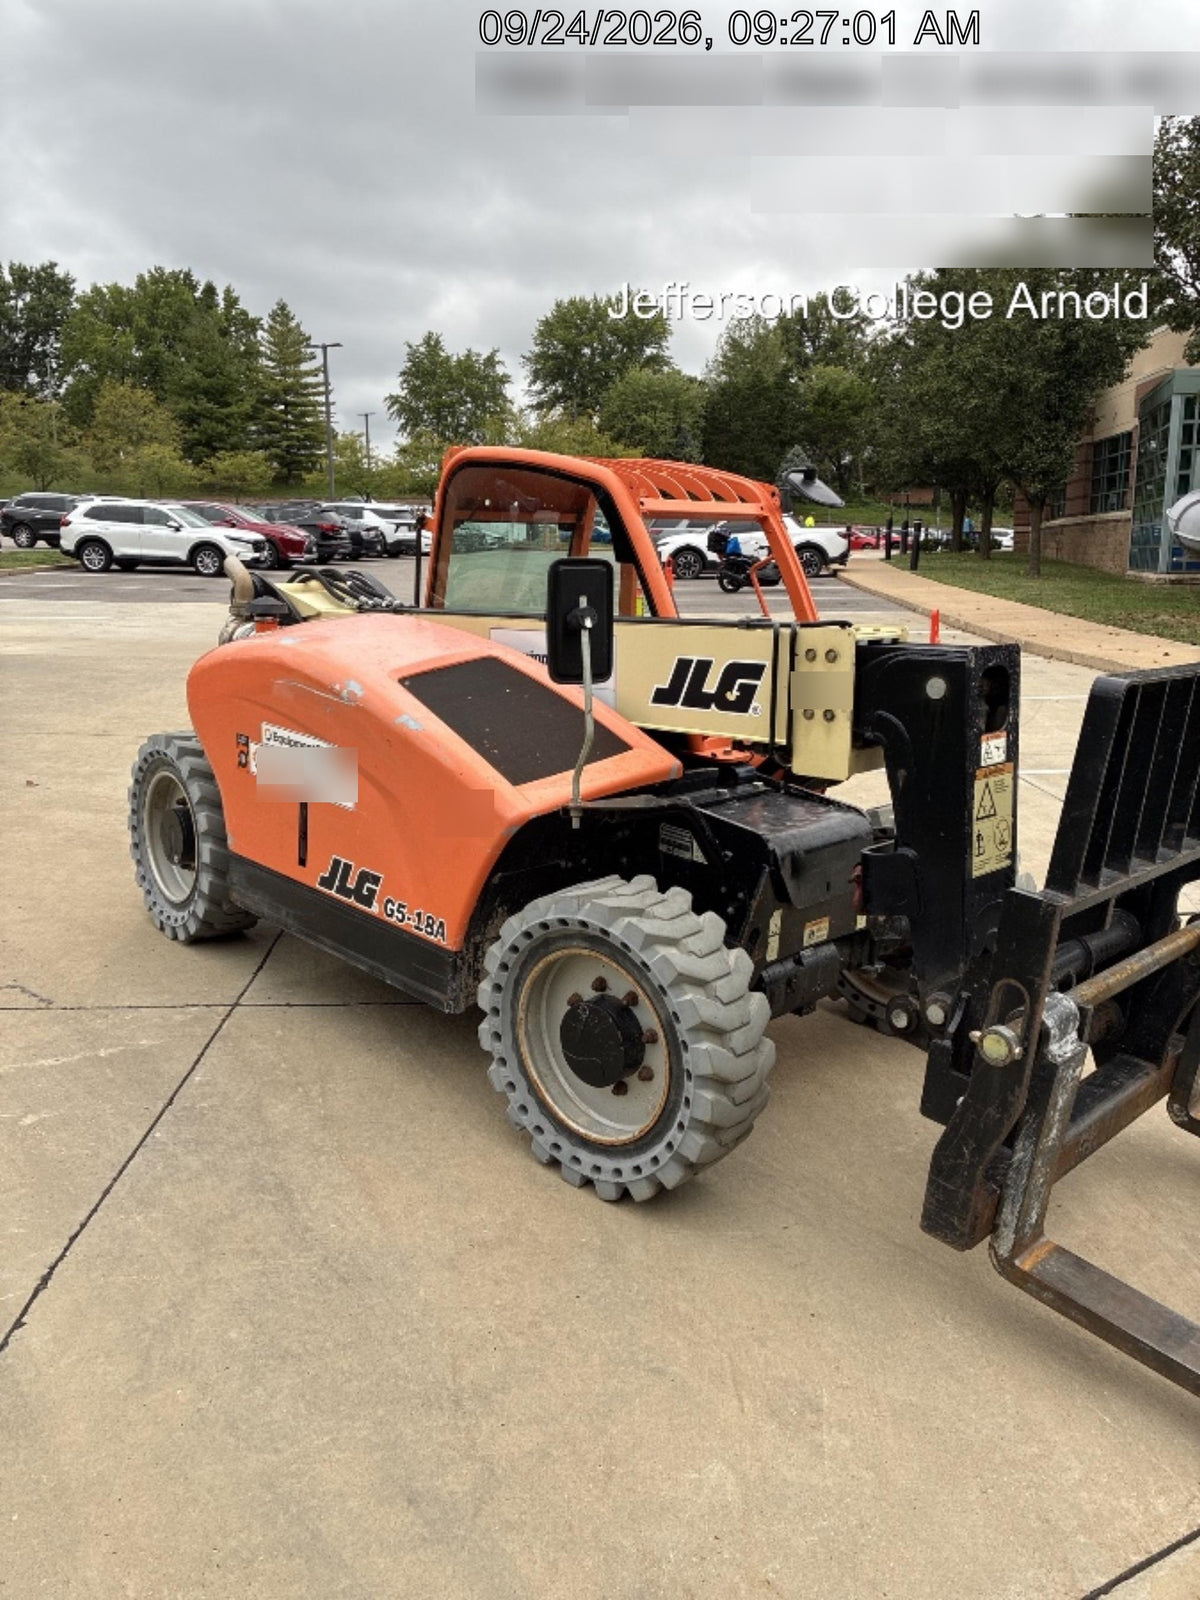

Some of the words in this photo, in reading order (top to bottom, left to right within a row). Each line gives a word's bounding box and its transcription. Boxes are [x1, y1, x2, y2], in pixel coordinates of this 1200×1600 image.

[650, 656, 768, 714] JLG
[317, 855, 383, 911] JLG
[383, 896, 447, 944] G5-18A
